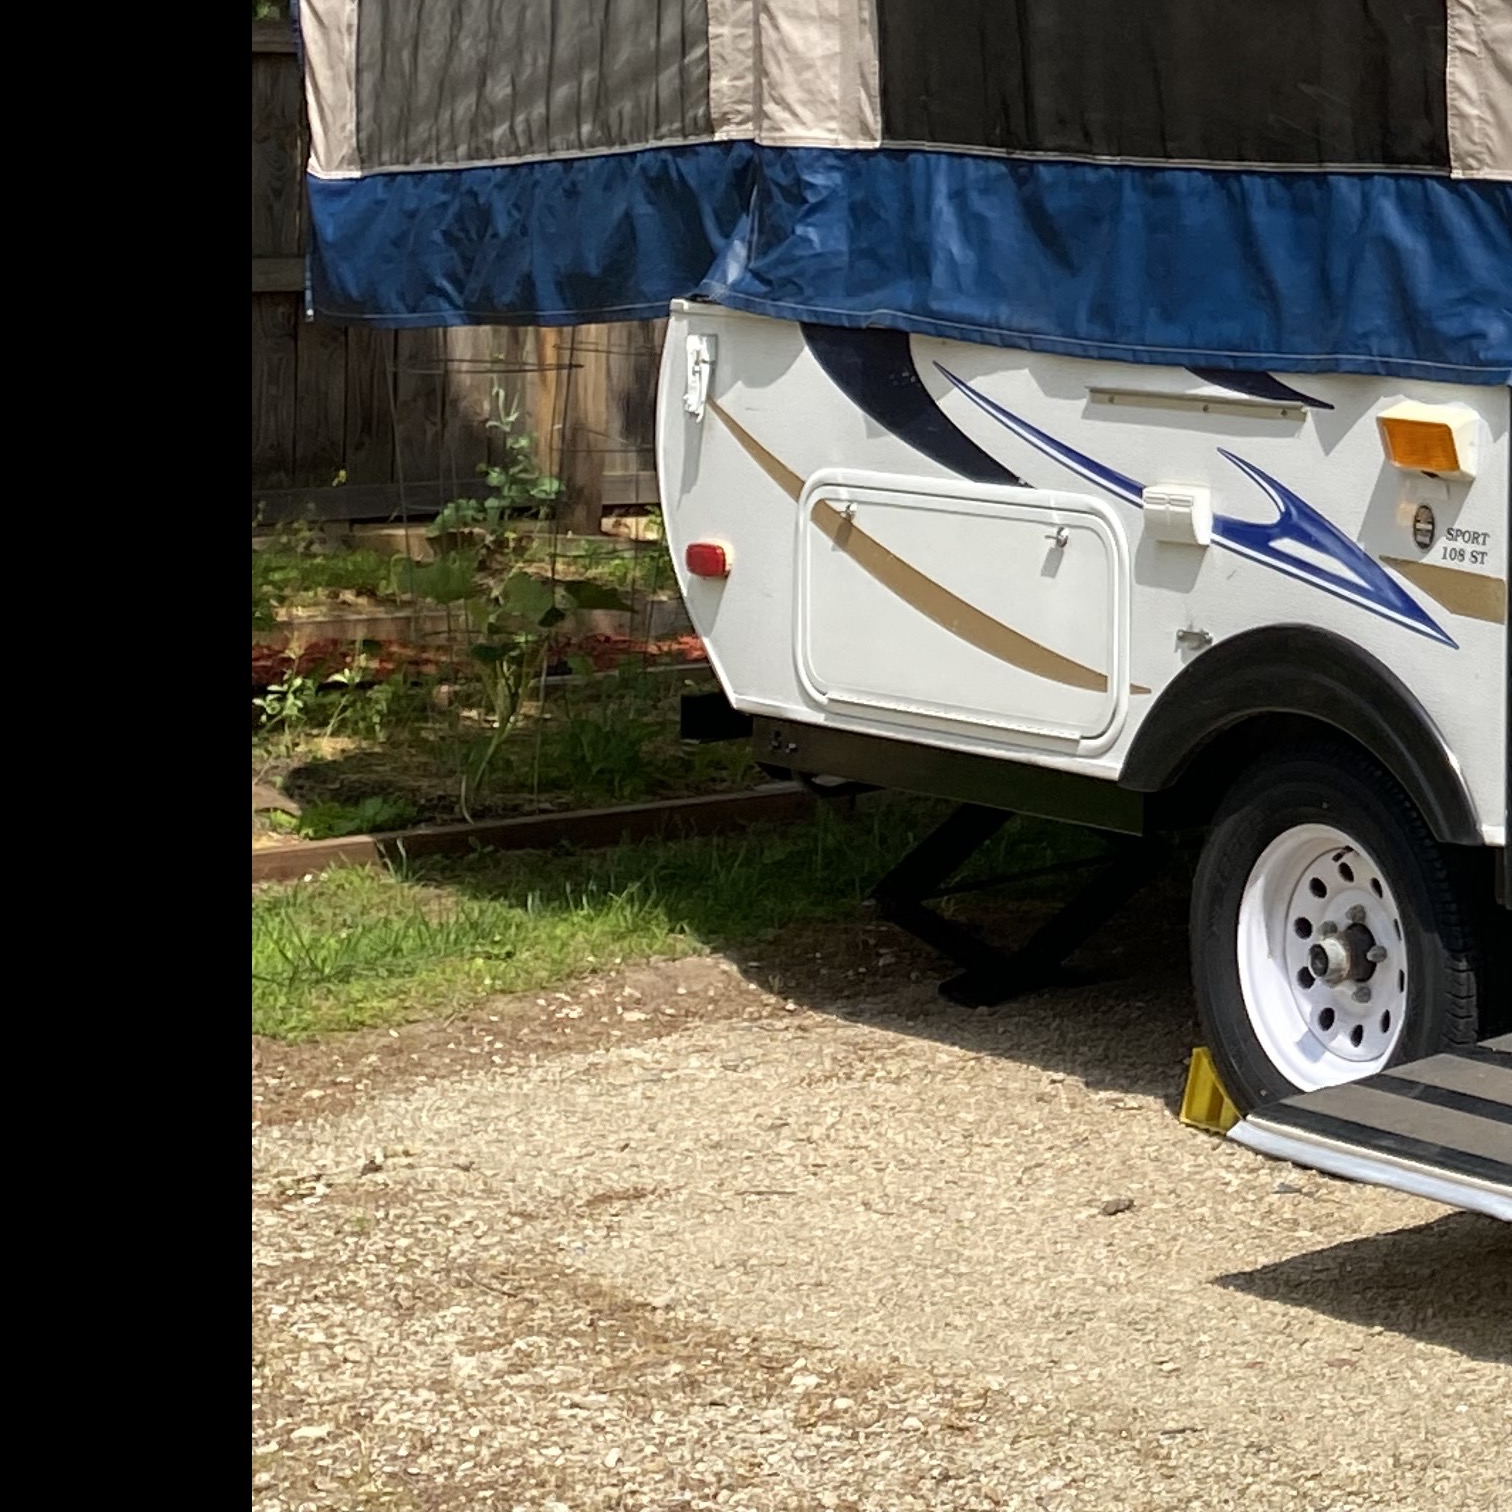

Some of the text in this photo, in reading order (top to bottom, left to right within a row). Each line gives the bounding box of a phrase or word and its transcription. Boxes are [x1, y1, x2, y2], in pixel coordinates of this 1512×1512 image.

[1446, 527, 1491, 546] SPORT
[1441, 546, 1488, 565] 108 ST
